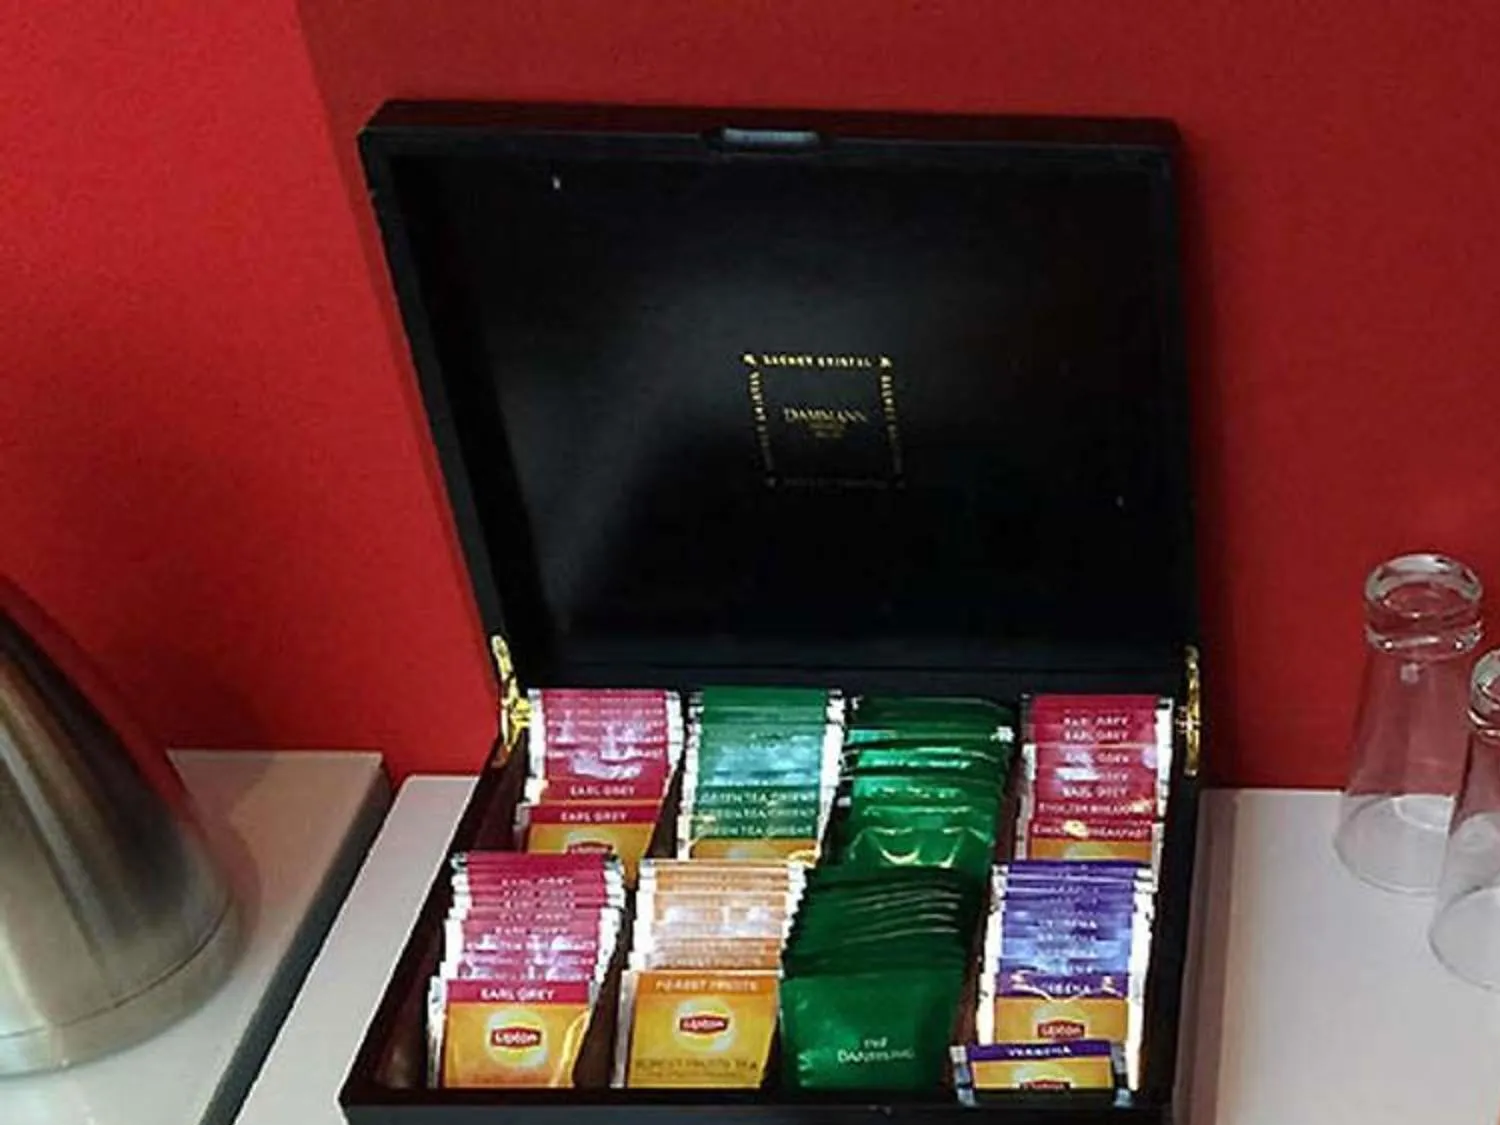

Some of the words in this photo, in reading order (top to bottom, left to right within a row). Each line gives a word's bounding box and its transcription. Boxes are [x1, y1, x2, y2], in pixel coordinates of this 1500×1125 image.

[569, 785, 600, 797] EARL
[602, 784, 635, 796] GREY
[560, 811, 591, 822] EARL
[593, 810, 628, 822] GREY
[480, 988, 516, 1001] EARL
[516, 987, 555, 1001] GREY
[494, 1028, 540, 1044] Lipton
